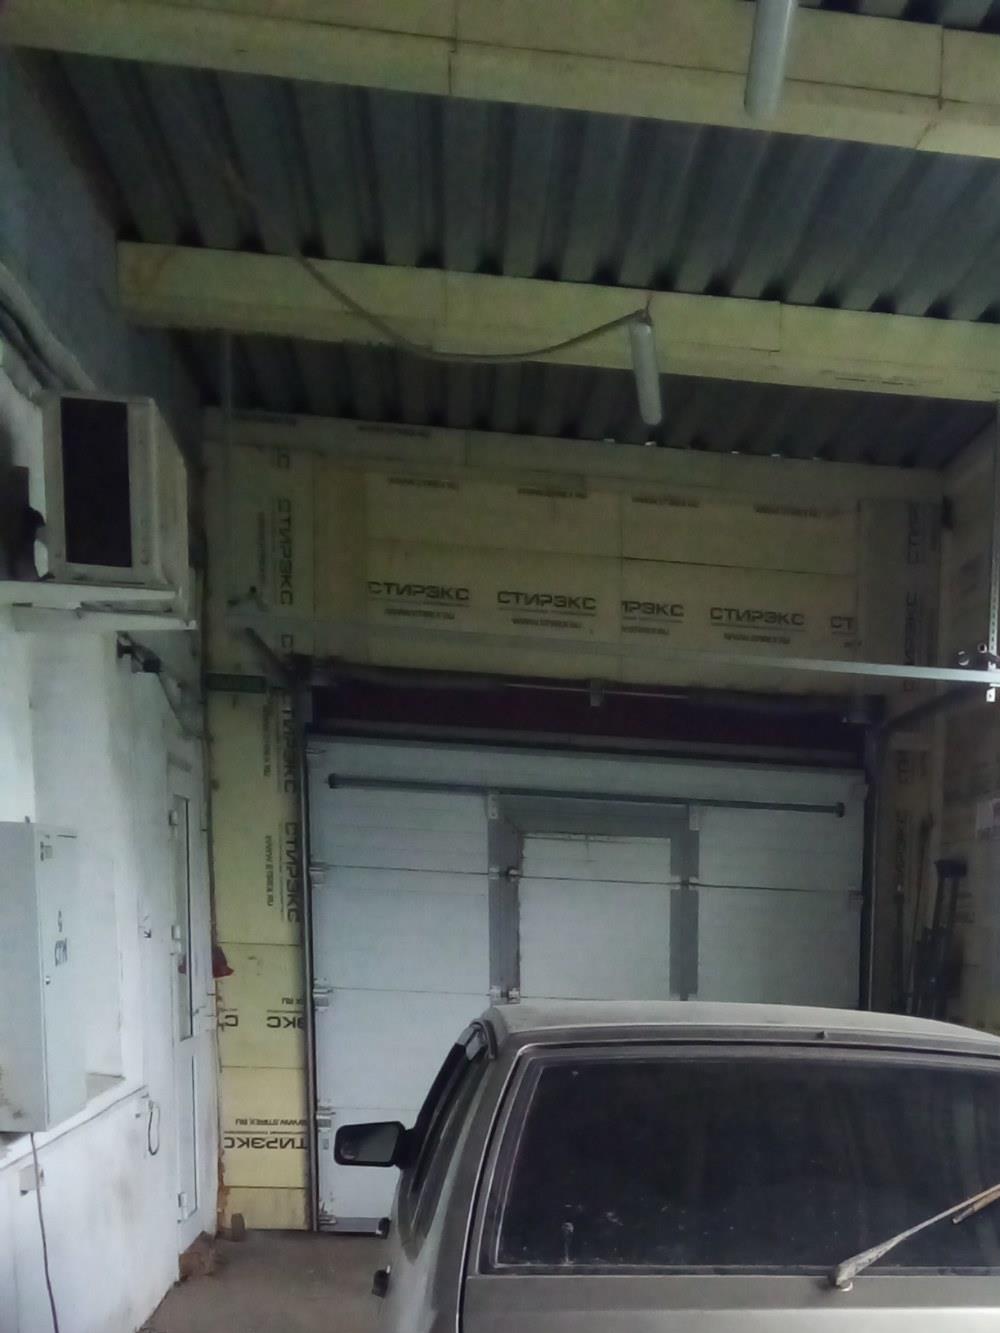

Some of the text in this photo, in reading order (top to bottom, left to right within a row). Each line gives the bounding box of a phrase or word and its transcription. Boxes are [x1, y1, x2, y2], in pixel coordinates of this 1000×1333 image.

[367, 581, 470, 602] СТИРЭКС
[496, 590, 597, 611] СТИРЭКС
[708, 606, 805, 627] СТИРЭКС
[285, 822, 300, 923] СТИРЭКС
